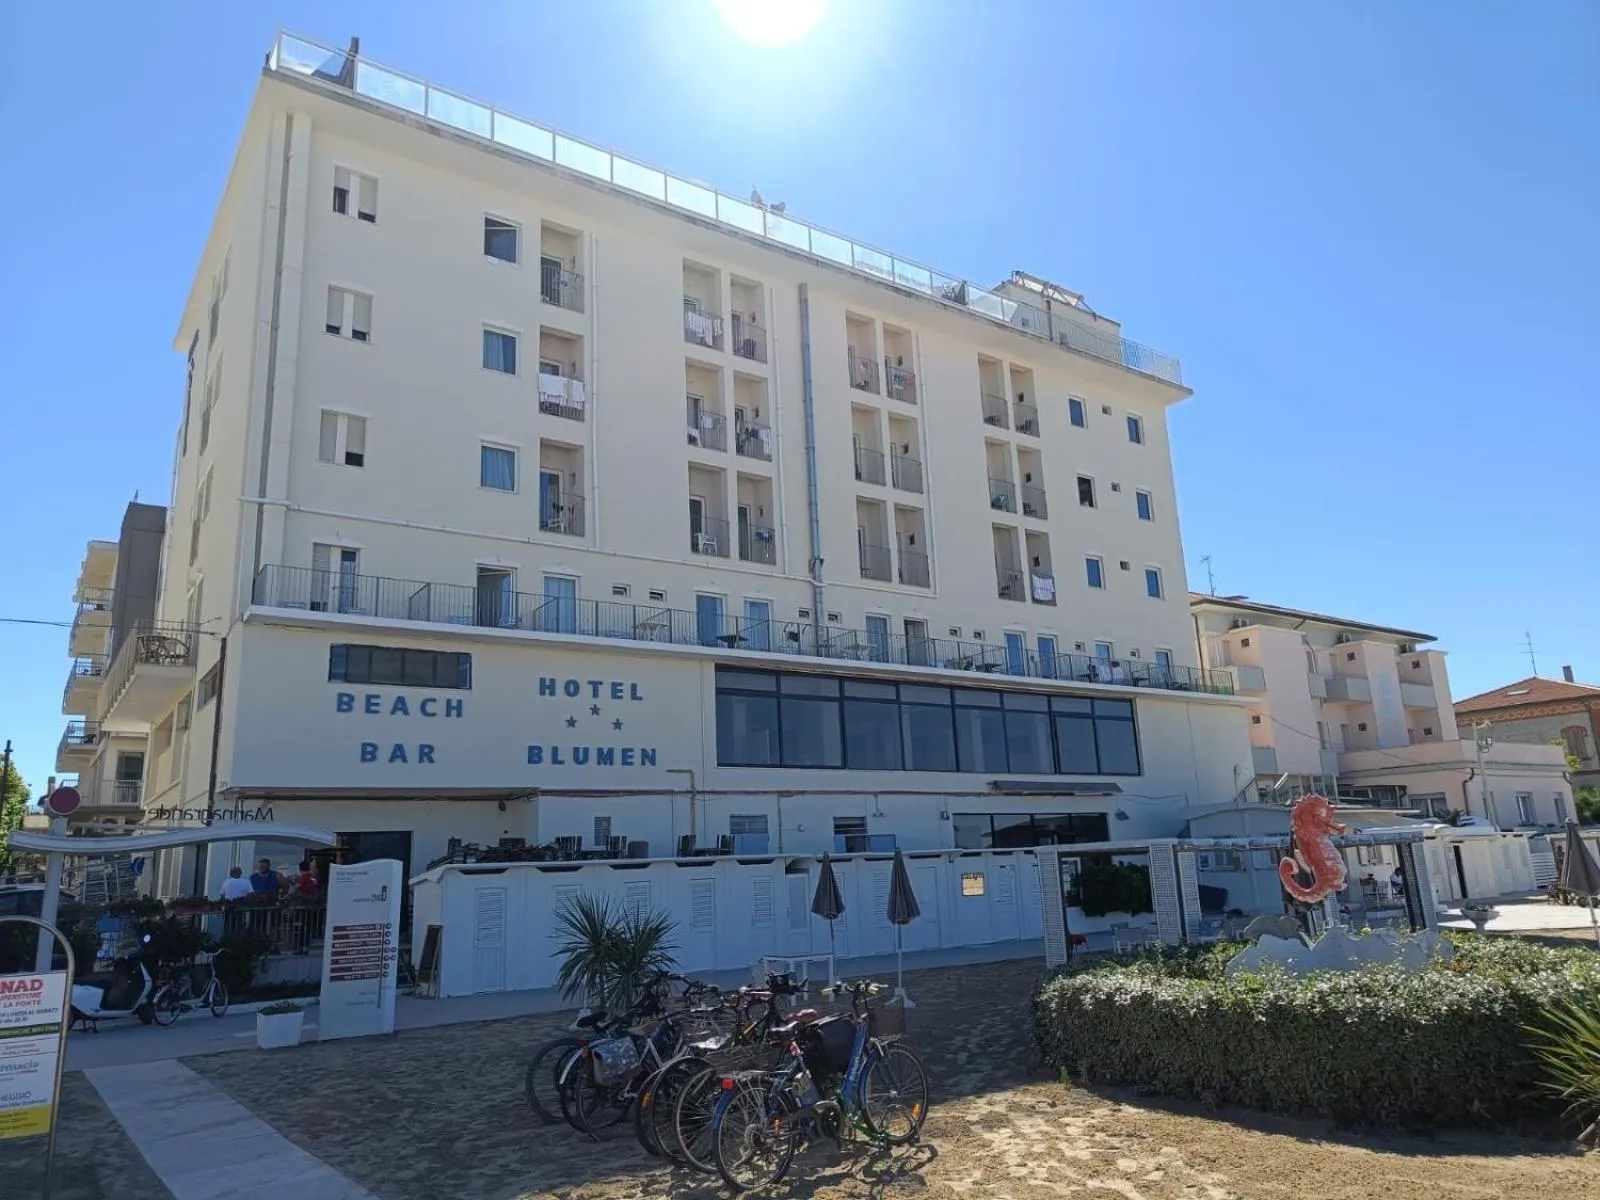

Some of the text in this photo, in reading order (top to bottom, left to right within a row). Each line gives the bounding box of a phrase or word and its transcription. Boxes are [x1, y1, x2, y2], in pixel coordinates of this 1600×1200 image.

[539, 677, 643, 701] HOTEL
[336, 692, 464, 718] BEACH
[360, 742, 436, 764] BAR
[527, 745, 657, 767] BLUMEN
